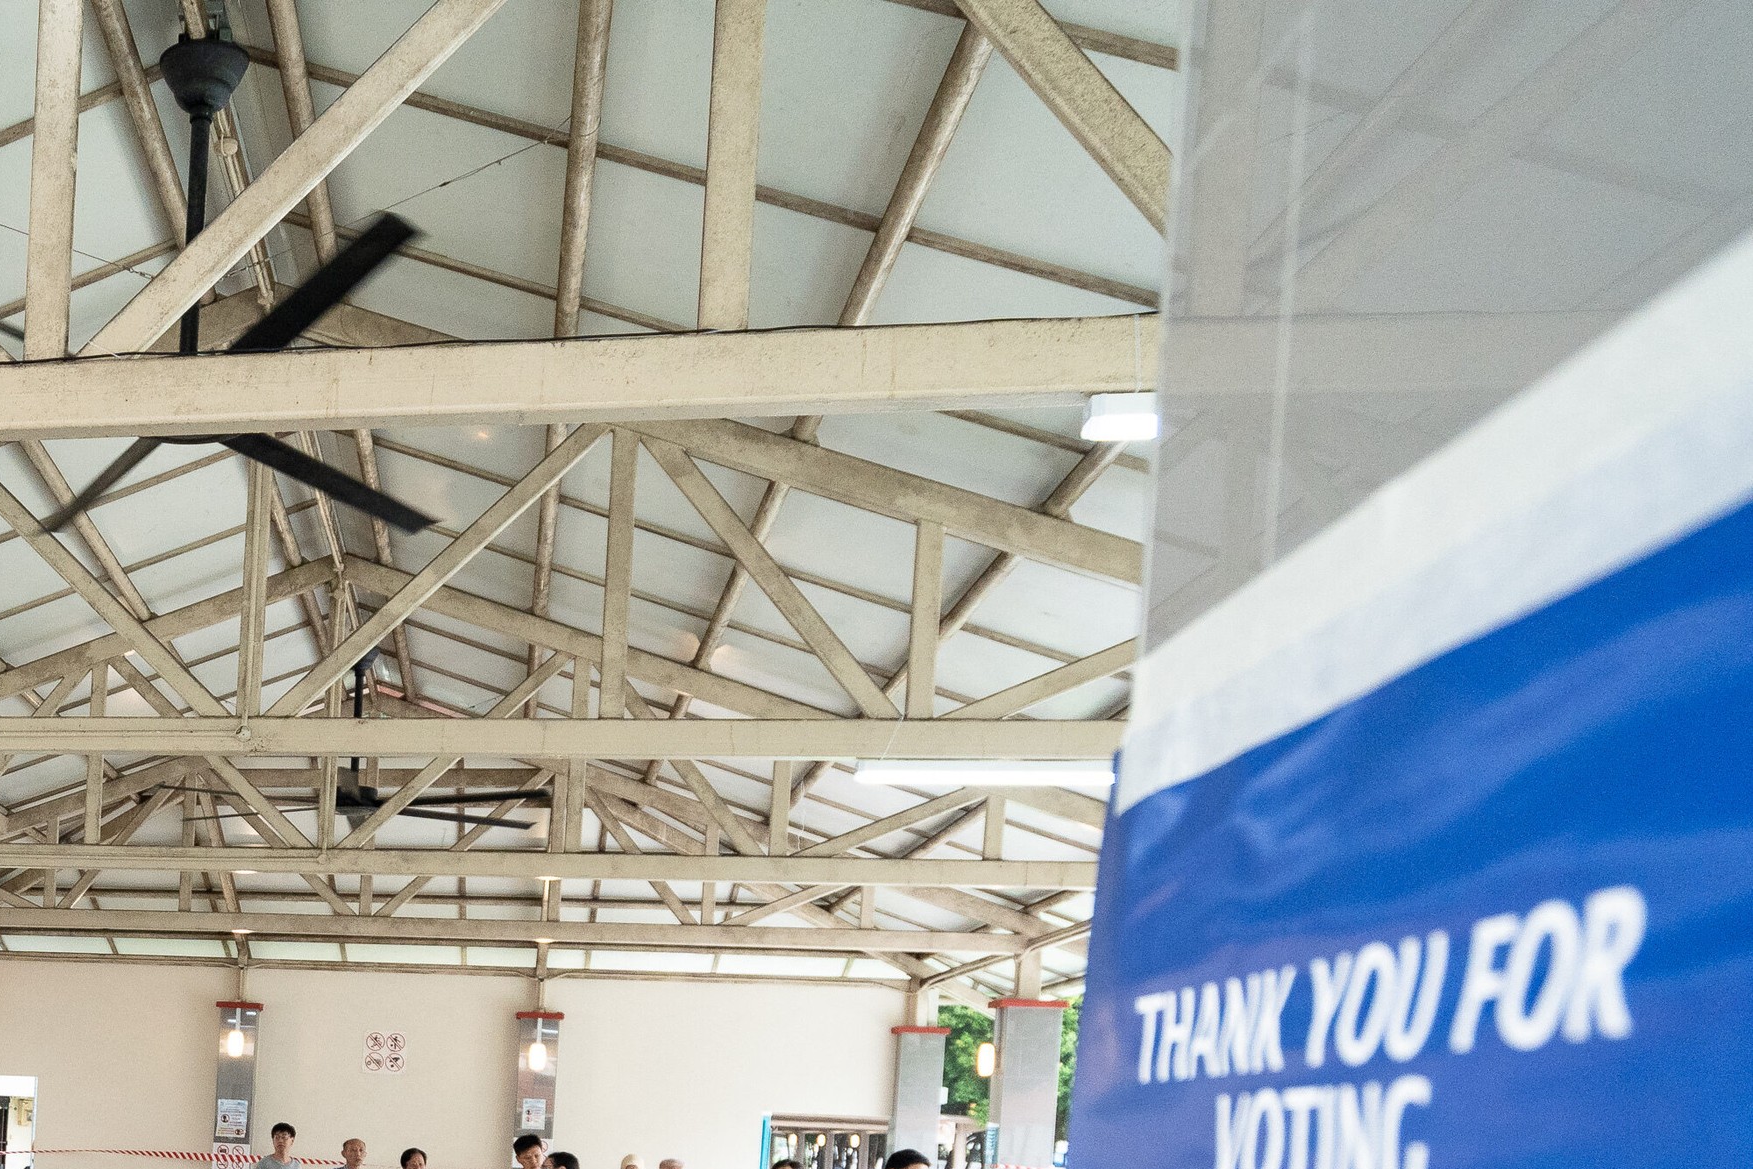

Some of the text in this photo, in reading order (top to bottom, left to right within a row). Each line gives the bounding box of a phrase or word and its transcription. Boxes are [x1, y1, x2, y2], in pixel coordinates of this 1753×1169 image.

[1133, 886, 1646, 1085] THANK YOU FOR
